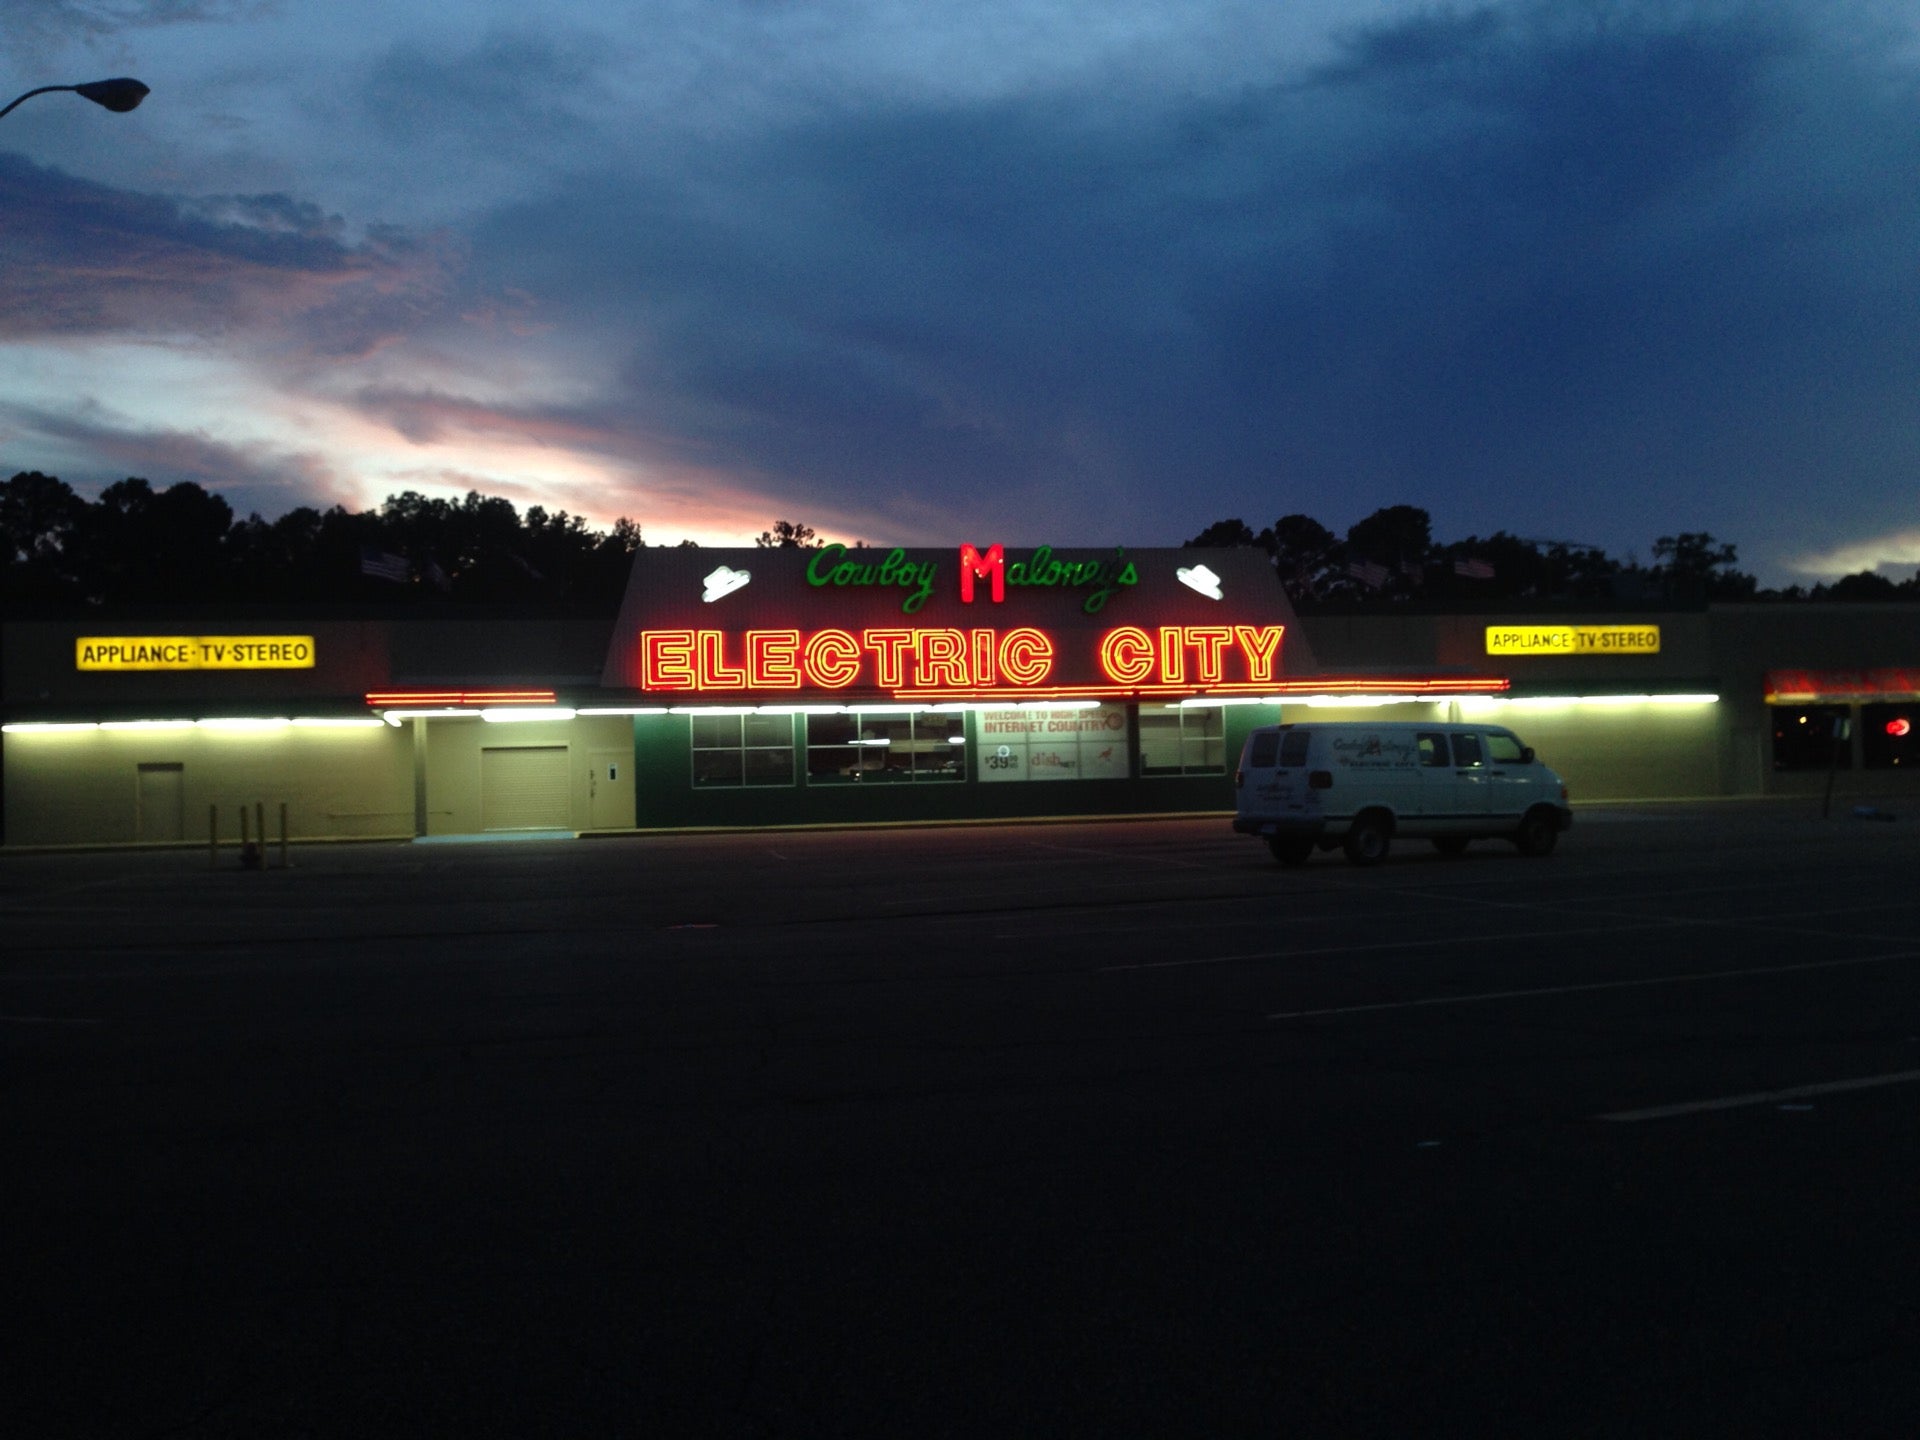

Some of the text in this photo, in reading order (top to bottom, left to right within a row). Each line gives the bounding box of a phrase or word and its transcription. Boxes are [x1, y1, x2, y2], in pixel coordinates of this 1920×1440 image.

[806, 543, 1139, 614] Cowboy Maloney's
[1493, 633, 1570, 648] APPLIANCE
[83, 645, 188, 662] APPLIANCE
[640, 625, 1284, 690] ELECTRIC CITY
[983, 711, 1032, 721] WELCOME
[1036, 711, 1048, 720] TO
[984, 720, 1107, 733] INTERNET COUNTRY
